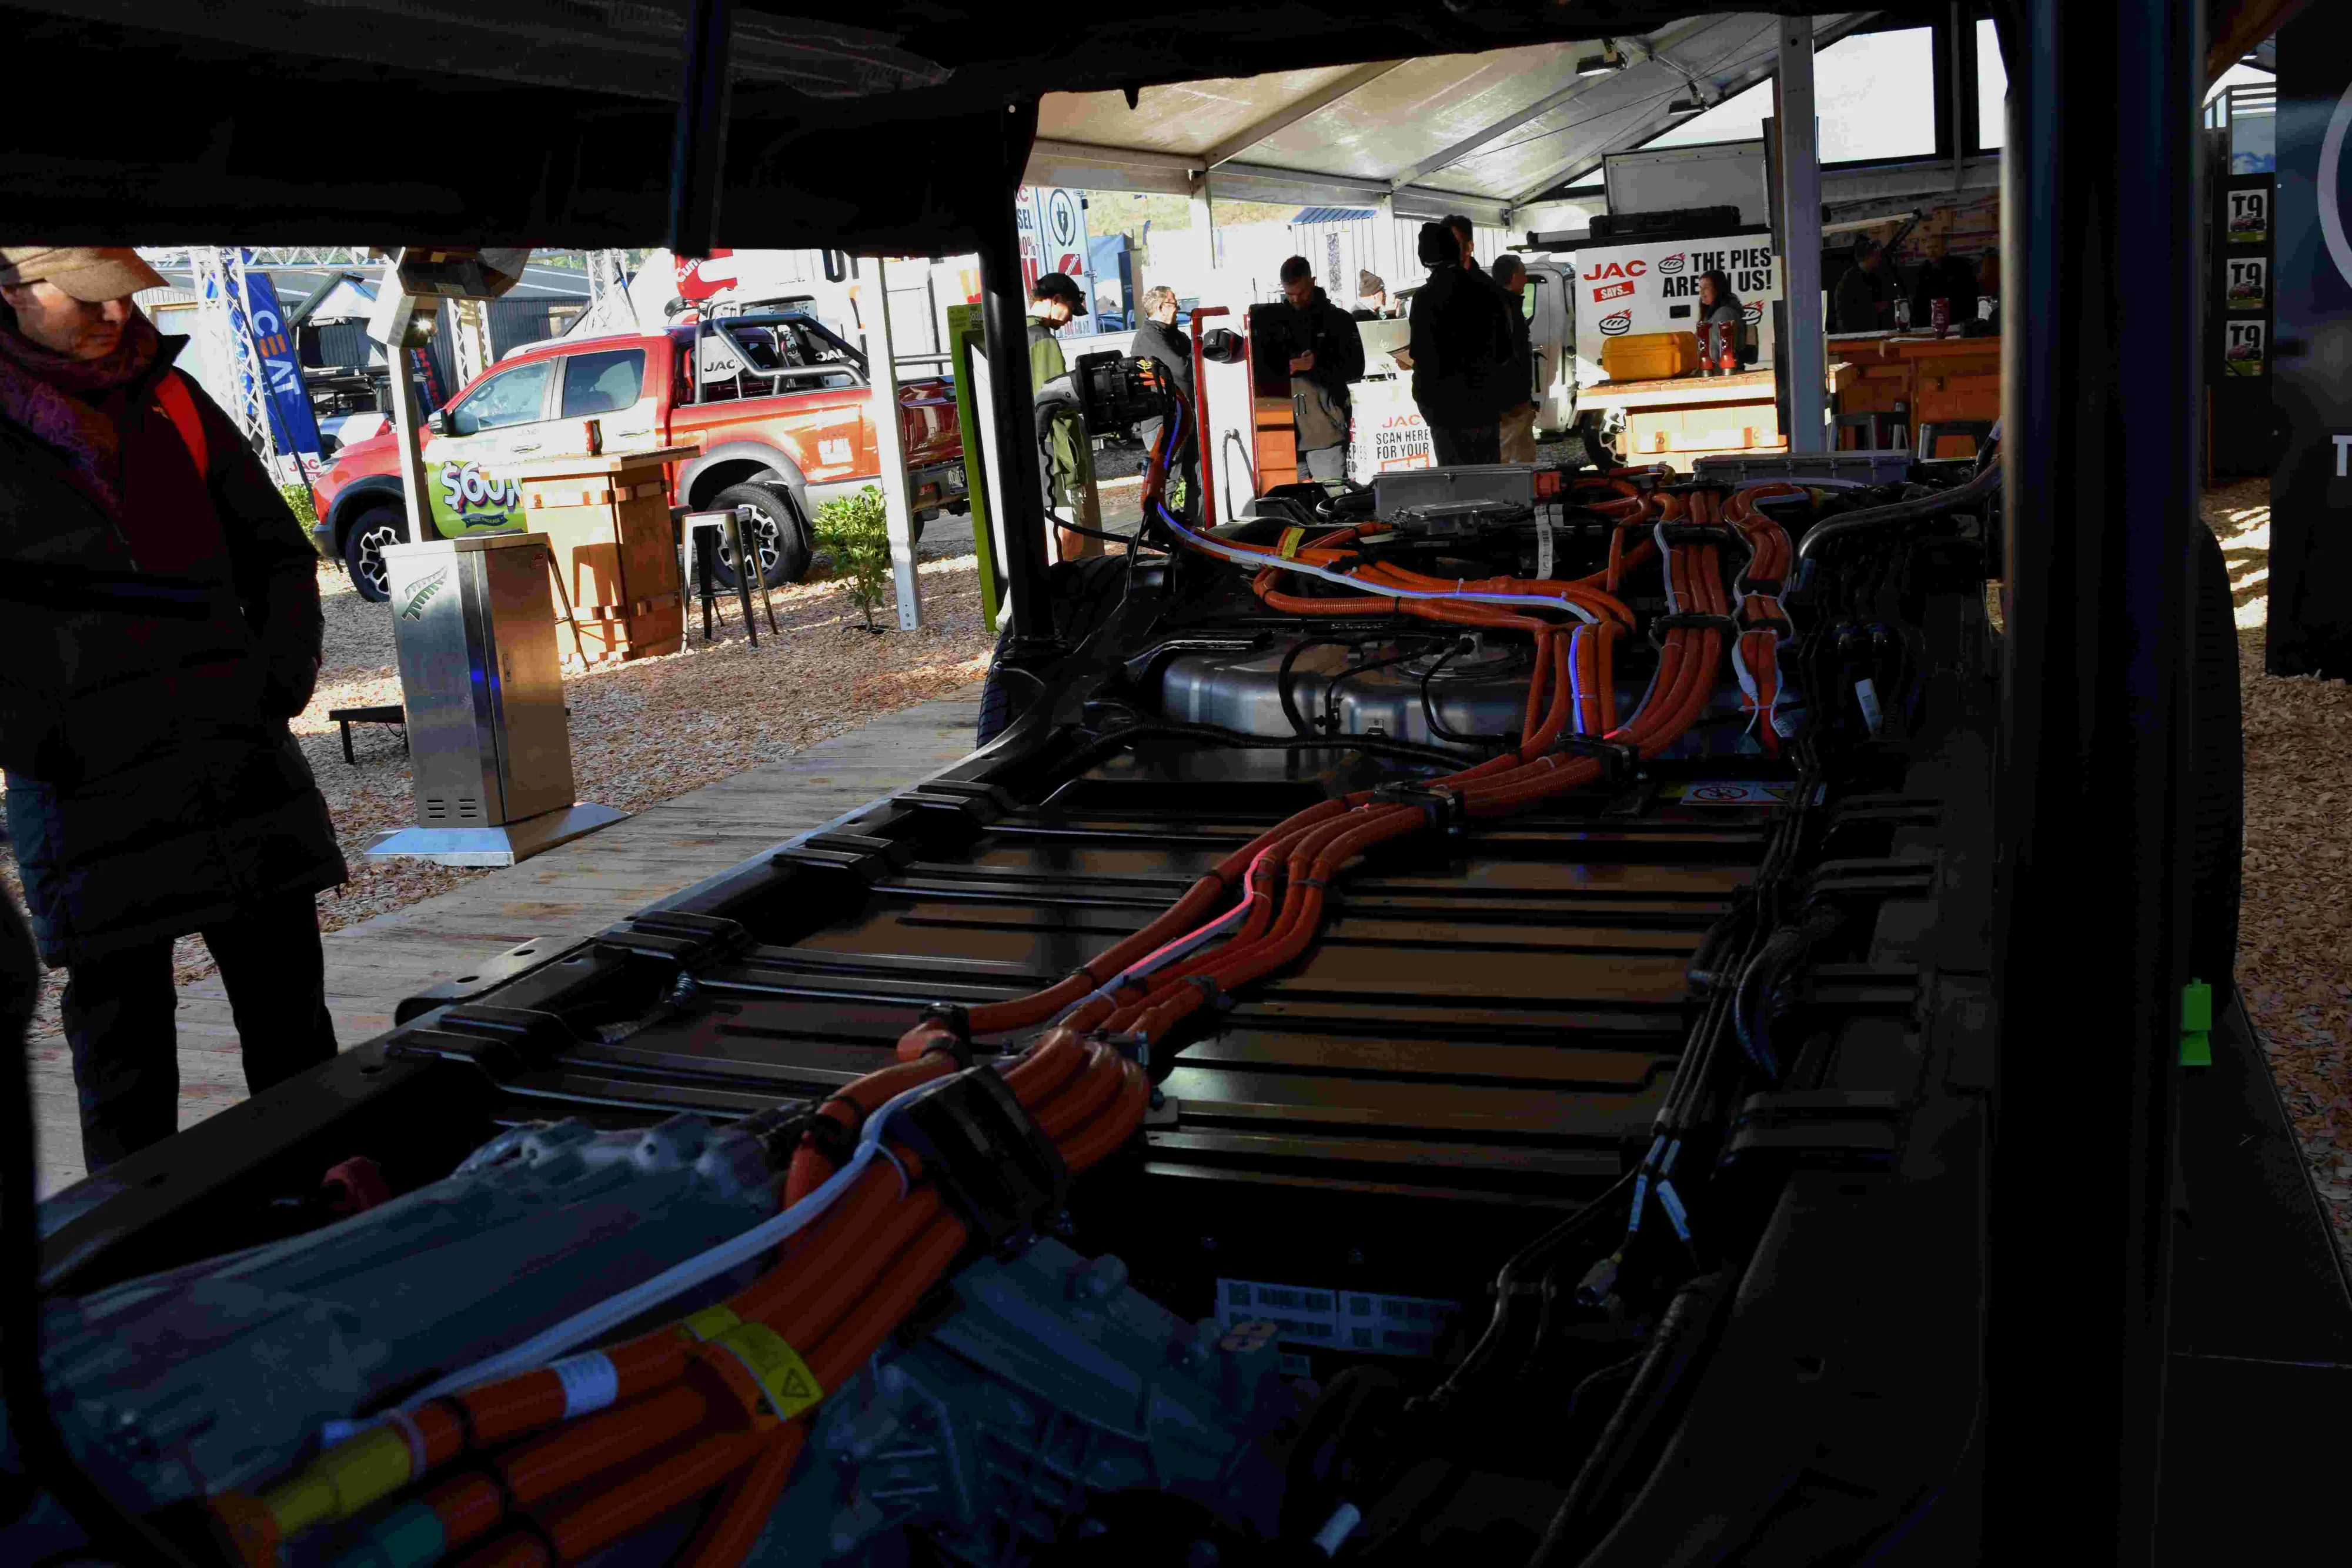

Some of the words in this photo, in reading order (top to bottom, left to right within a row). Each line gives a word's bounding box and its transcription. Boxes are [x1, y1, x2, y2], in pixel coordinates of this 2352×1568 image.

[2232, 195, 2263, 218] T9
[1583, 260, 1647, 280] JAC
[1691, 252, 1725, 272] THE
[1730, 247, 1772, 269] PIES
[1662, 275, 1699, 298] ARE
[1738, 269, 1772, 292] US!
[2230, 263, 2261, 287] T9
[2229, 325, 2260, 350] T9
[252, 310, 300, 396] CEAT
[704, 358, 736, 372] JAC
[1381, 414, 1422, 428] JAC
[1376, 431, 1402, 445] SCAN
[1405, 429, 1429, 442] HERE
[1377, 446, 1397, 459] FOR
[1400, 442, 1429, 457] YOUR
[2331, 434, 2352, 477] T
[289, 459, 320, 472] JAC
